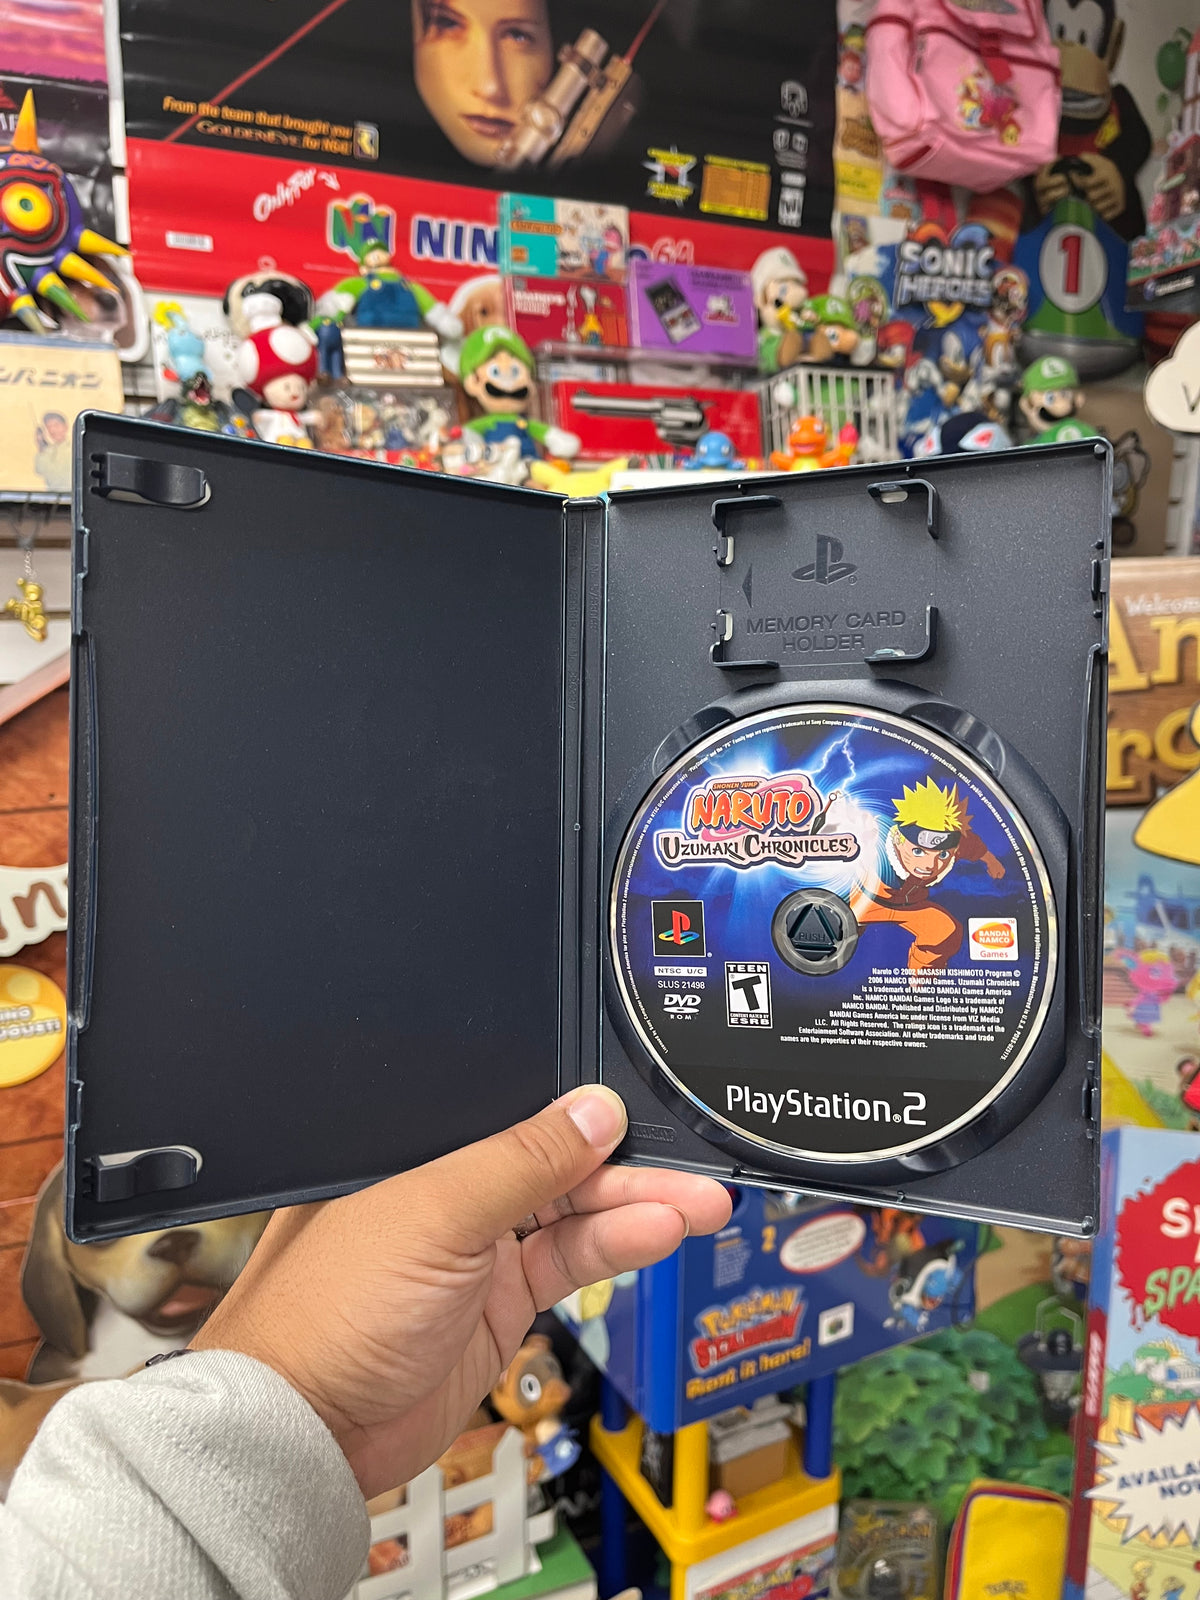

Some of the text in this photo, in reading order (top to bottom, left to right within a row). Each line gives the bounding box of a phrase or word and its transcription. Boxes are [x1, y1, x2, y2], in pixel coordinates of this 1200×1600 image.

[283, 114, 330, 136] brought
[900, 241, 995, 278] SONIC
[899, 274, 994, 307] HEROES
[747, 610, 906, 636] MEMORY CARD
[783, 634, 865, 653] HOLDER
[691, 789, 813, 831] NARUTO
[800, 932, 826, 942] PUSH
[980, 950, 1009, 958] Games
[727, 964, 767, 973] TEEN
[917, 968, 946, 976] MASASHI
[948, 969, 984, 977] KISHIMOTO
[985, 970, 1012, 978] Program
[658, 980, 706, 989] SLUS 21498
[933, 978, 956, 986] Games.
[958, 978, 985, 986] Uzumaki
[986, 979, 1020, 987] Chronicles
[731, 975, 762, 1011] T
[874, 985, 904, 993] trademark
[912, 986, 936, 994] NAMCO
[985, 988, 1012, 996] America
[663, 993, 702, 1007] DVD
[865, 994, 888, 1002] NAMCO
[936, 996, 952, 1004] Logo
[952, 996, 958, 1004] is
[965, 997, 997, 1005] trademark
[892, 1004, 921, 1012] Published
[935, 1005, 970, 1013] Distributed
[970, 1006, 978, 1014] by
[730, 1017, 770, 1025] ESRB
[829, 1010, 851, 1018] BANDAI
[874, 1012, 899, 1020] America
[929, 1014, 952, 1022] license
[952, 1014, 966, 1022] from
[980, 1016, 1000, 1024] Media
[815, 1018, 828, 1026] LLC.
[840, 1020, 858, 1028] Rights
[860, 1020, 889, 1028] Reserved.
[905, 1022, 926, 1030] ratings
[954, 1024, 986, 1032] trademark
[799, 1027, 838, 1035] Entertainment
[839, 1028, 864, 1036] Software
[865, 1030, 900, 1038] Association.
[929, 1032, 964, 1040] trademarks
[978, 1034, 994, 1042] trade
[820, 1037, 850, 1046] properties
[858, 1038, 871, 1046] their
[872, 1039, 902, 1048] respective
[686, 1367, 736, 1399] Rent
[739, 1359, 757, 1380] it
[759, 1337, 812, 1372] here!
